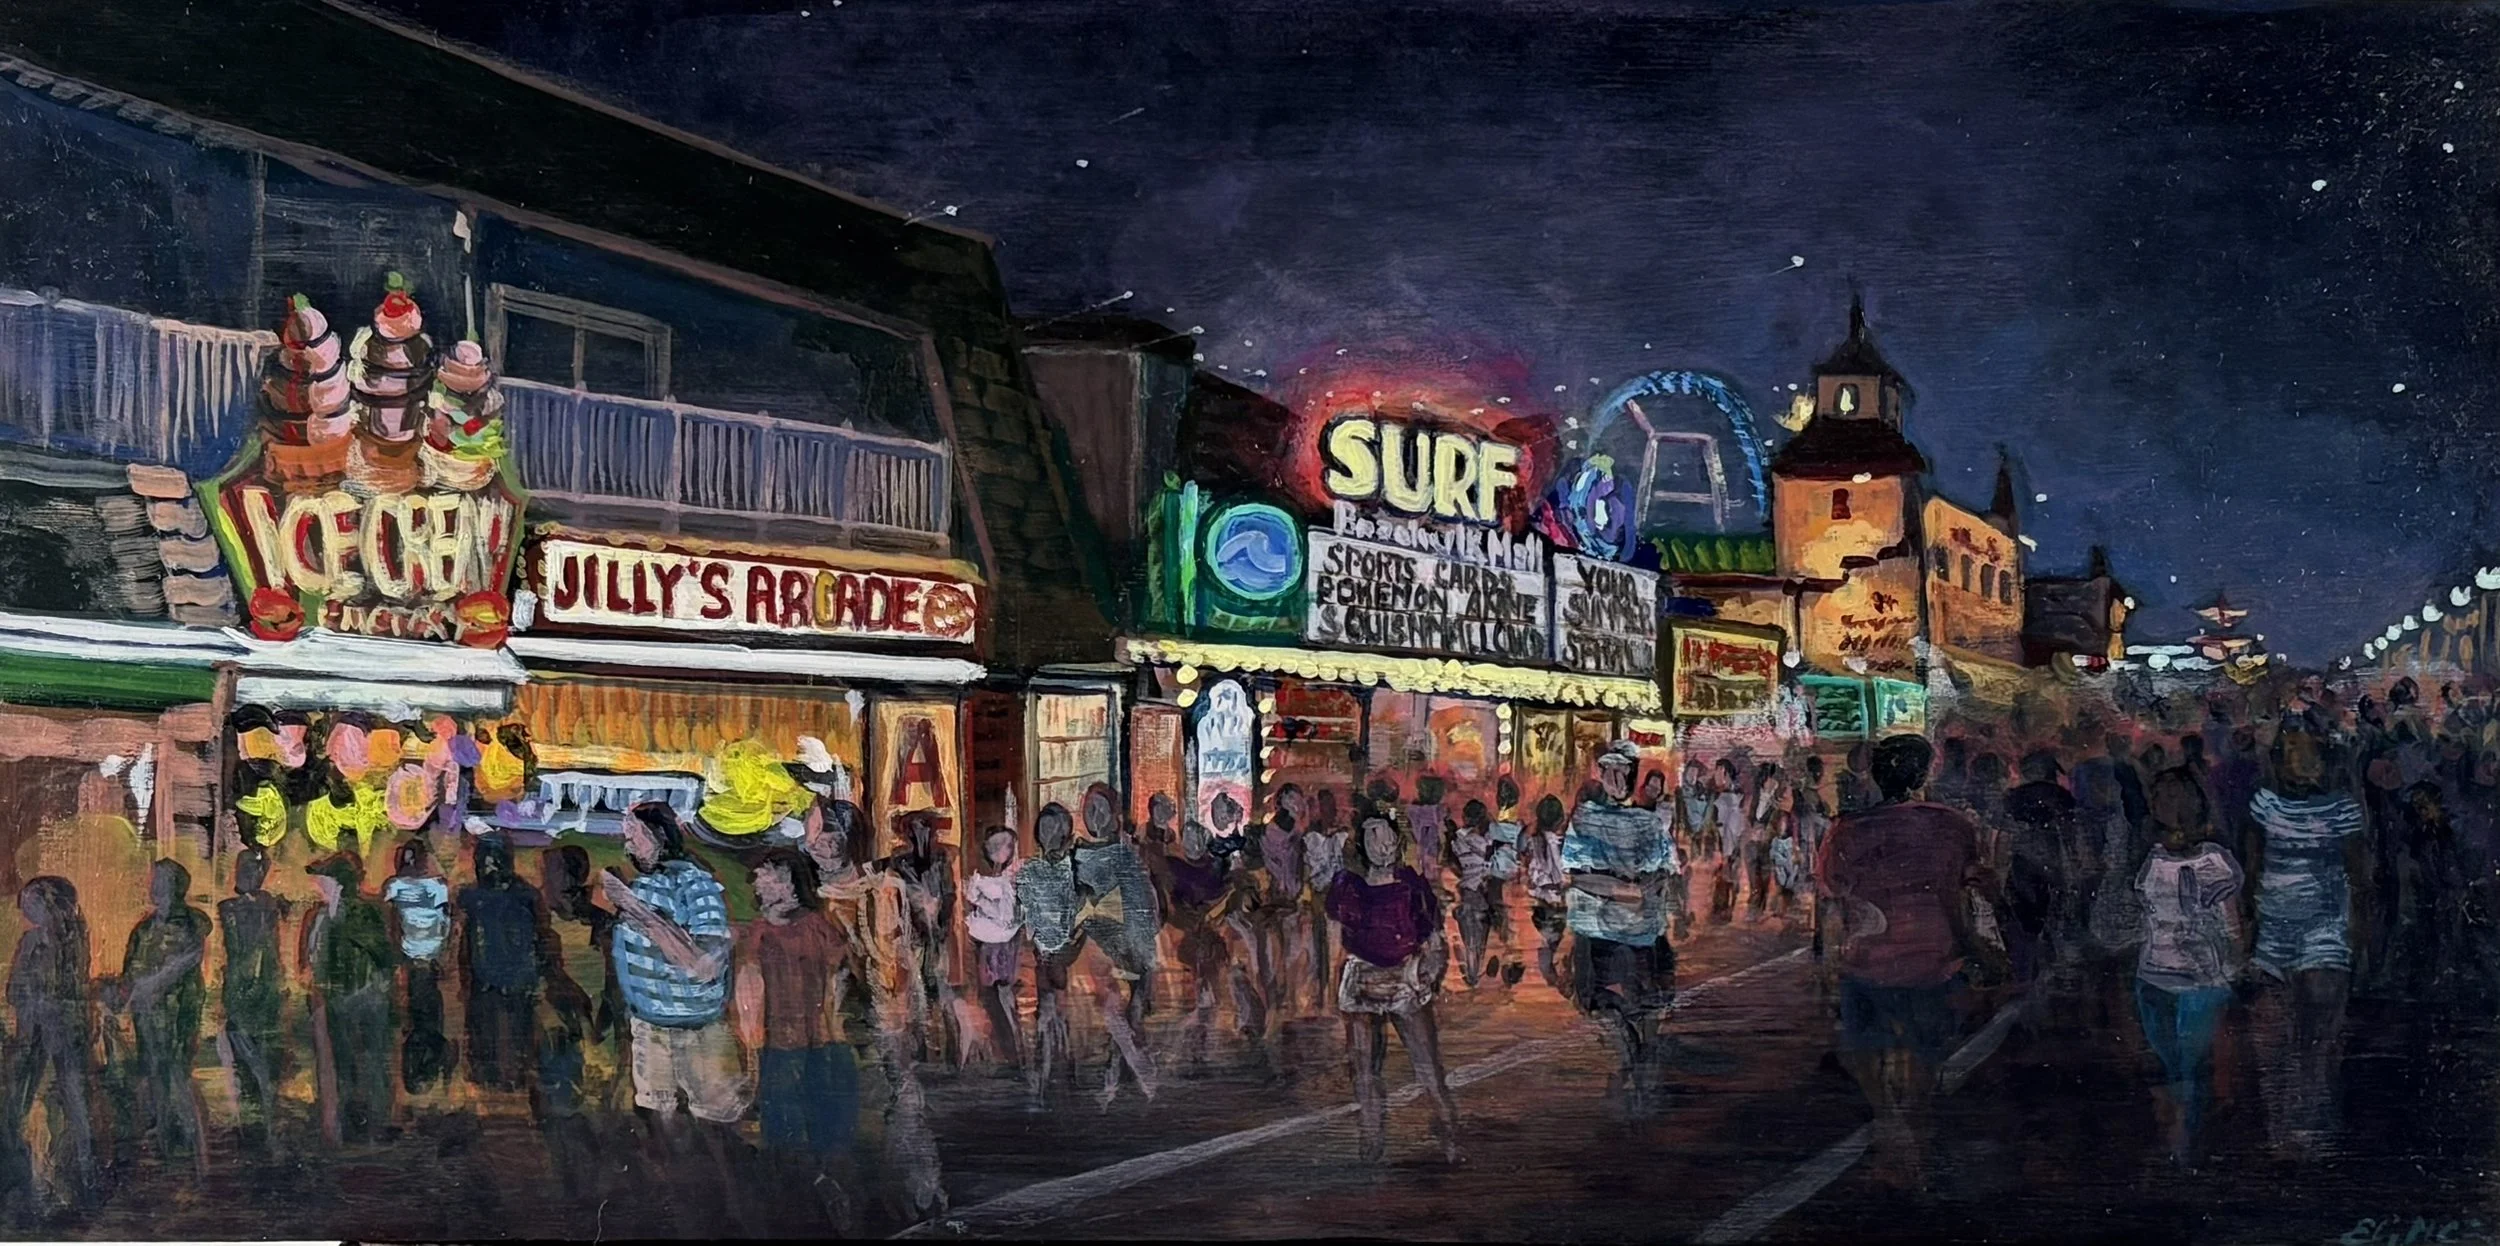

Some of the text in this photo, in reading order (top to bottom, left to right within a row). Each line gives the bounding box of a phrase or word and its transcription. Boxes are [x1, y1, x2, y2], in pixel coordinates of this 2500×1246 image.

[1326, 418, 1522, 523] SURF
[244, 488, 365, 600] ICE
[1323, 542, 1416, 583] SPORTS
[553, 554, 923, 632] JILLY'S ARCADE
[890, 717, 951, 807] A
